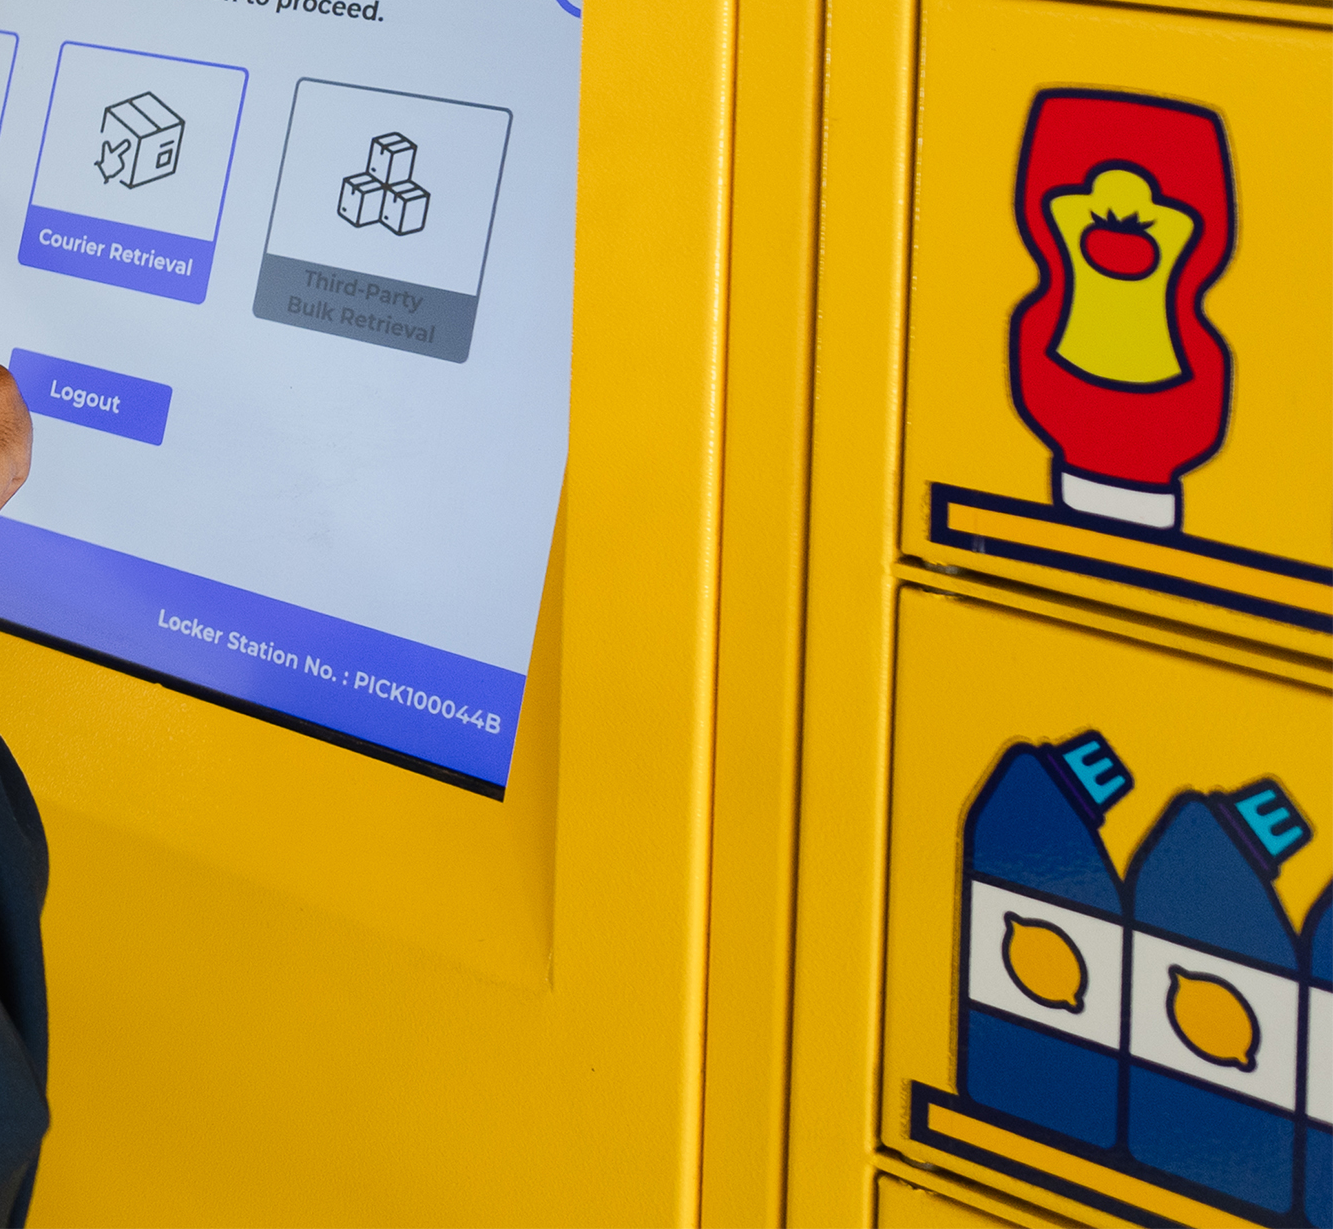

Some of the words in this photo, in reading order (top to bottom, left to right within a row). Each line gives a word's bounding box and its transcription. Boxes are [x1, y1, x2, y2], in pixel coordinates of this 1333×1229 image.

[38, 228, 106, 258] Courier
[109, 241, 194, 277] Retrieval
[304, 269, 424, 313] Third-Party
[287, 295, 335, 323] Bulk
[340, 307, 435, 344] Retrieval
[49, 379, 121, 414] Logout
[158, 609, 223, 645] Locker
[227, 632, 299, 670] Station
[304, 655, 337, 683] No.
[354, 671, 502, 735] PICK100044B
